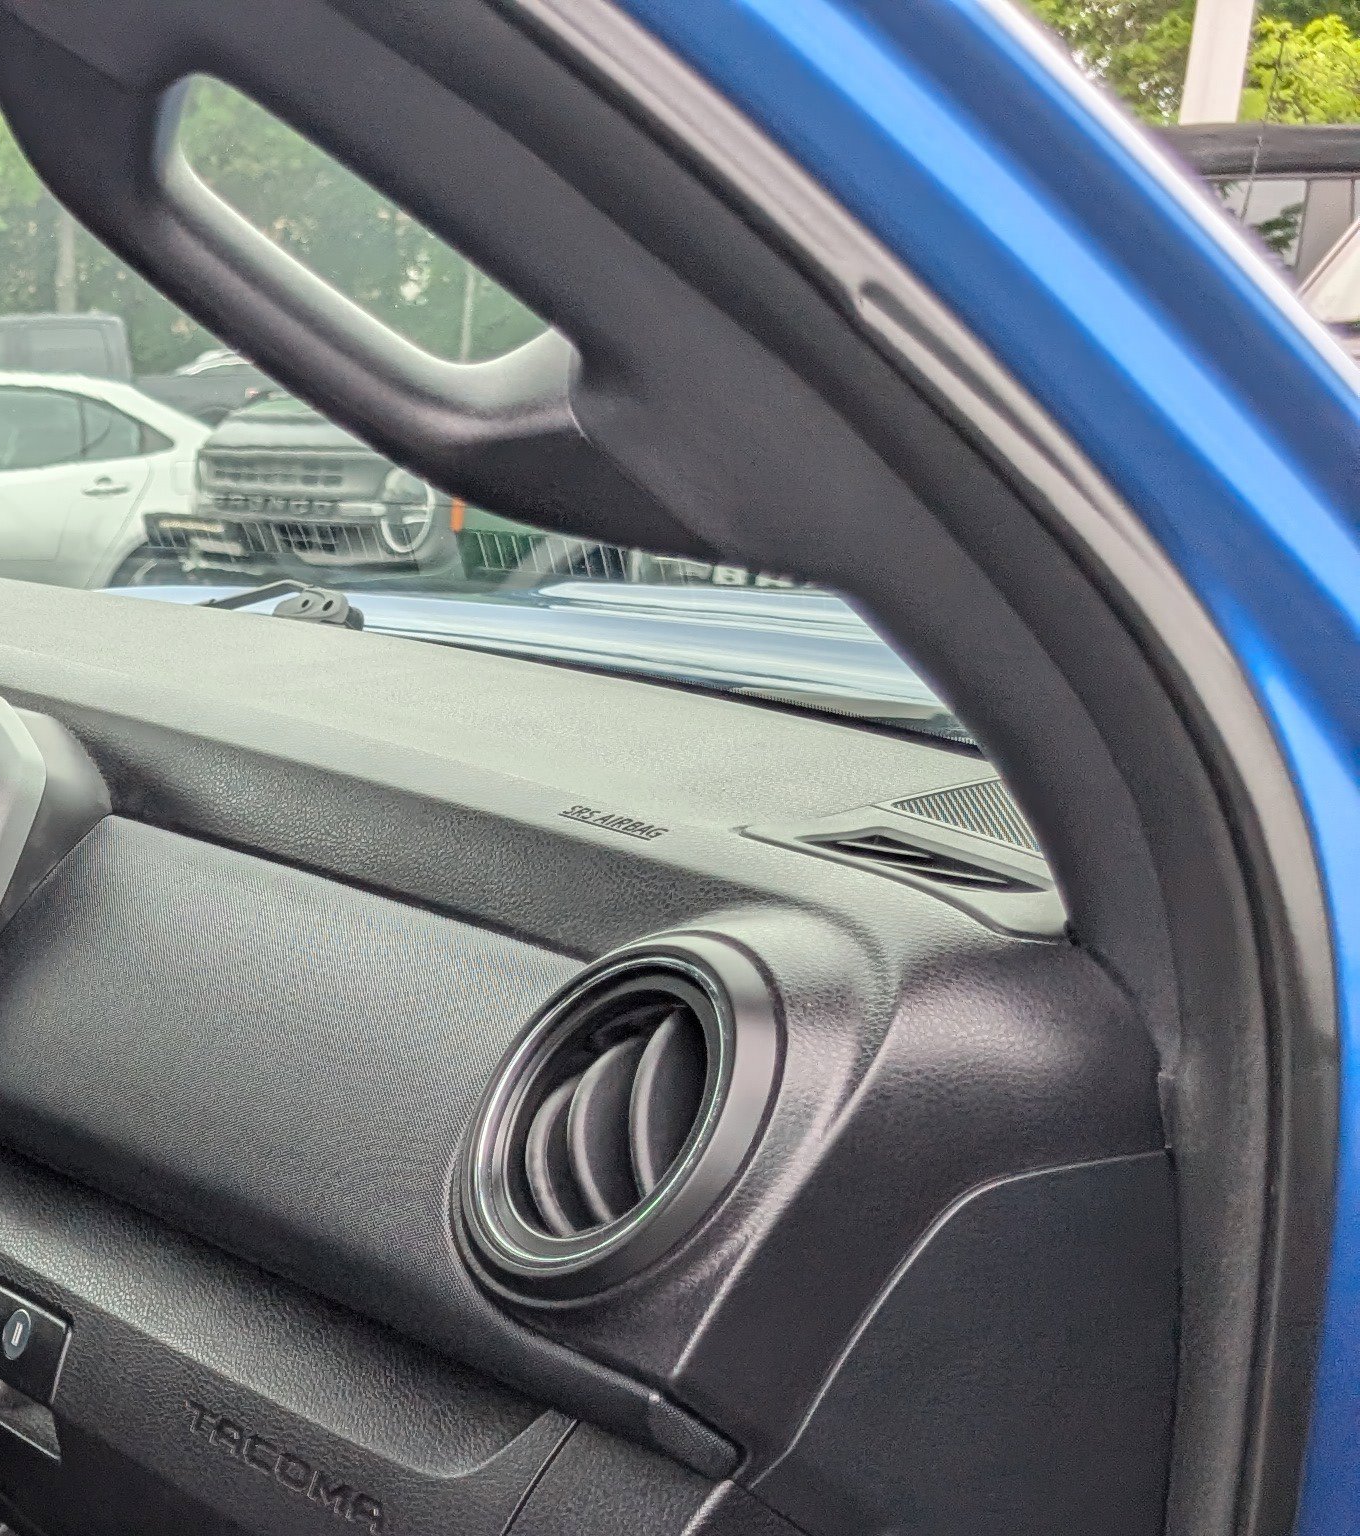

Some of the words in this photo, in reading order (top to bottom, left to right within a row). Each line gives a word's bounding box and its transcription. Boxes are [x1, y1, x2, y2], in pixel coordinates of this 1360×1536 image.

[561, 805, 602, 820] SRS
[592, 813, 670, 839] AIRBAG
[183, 1399, 383, 1536] TACOMA
